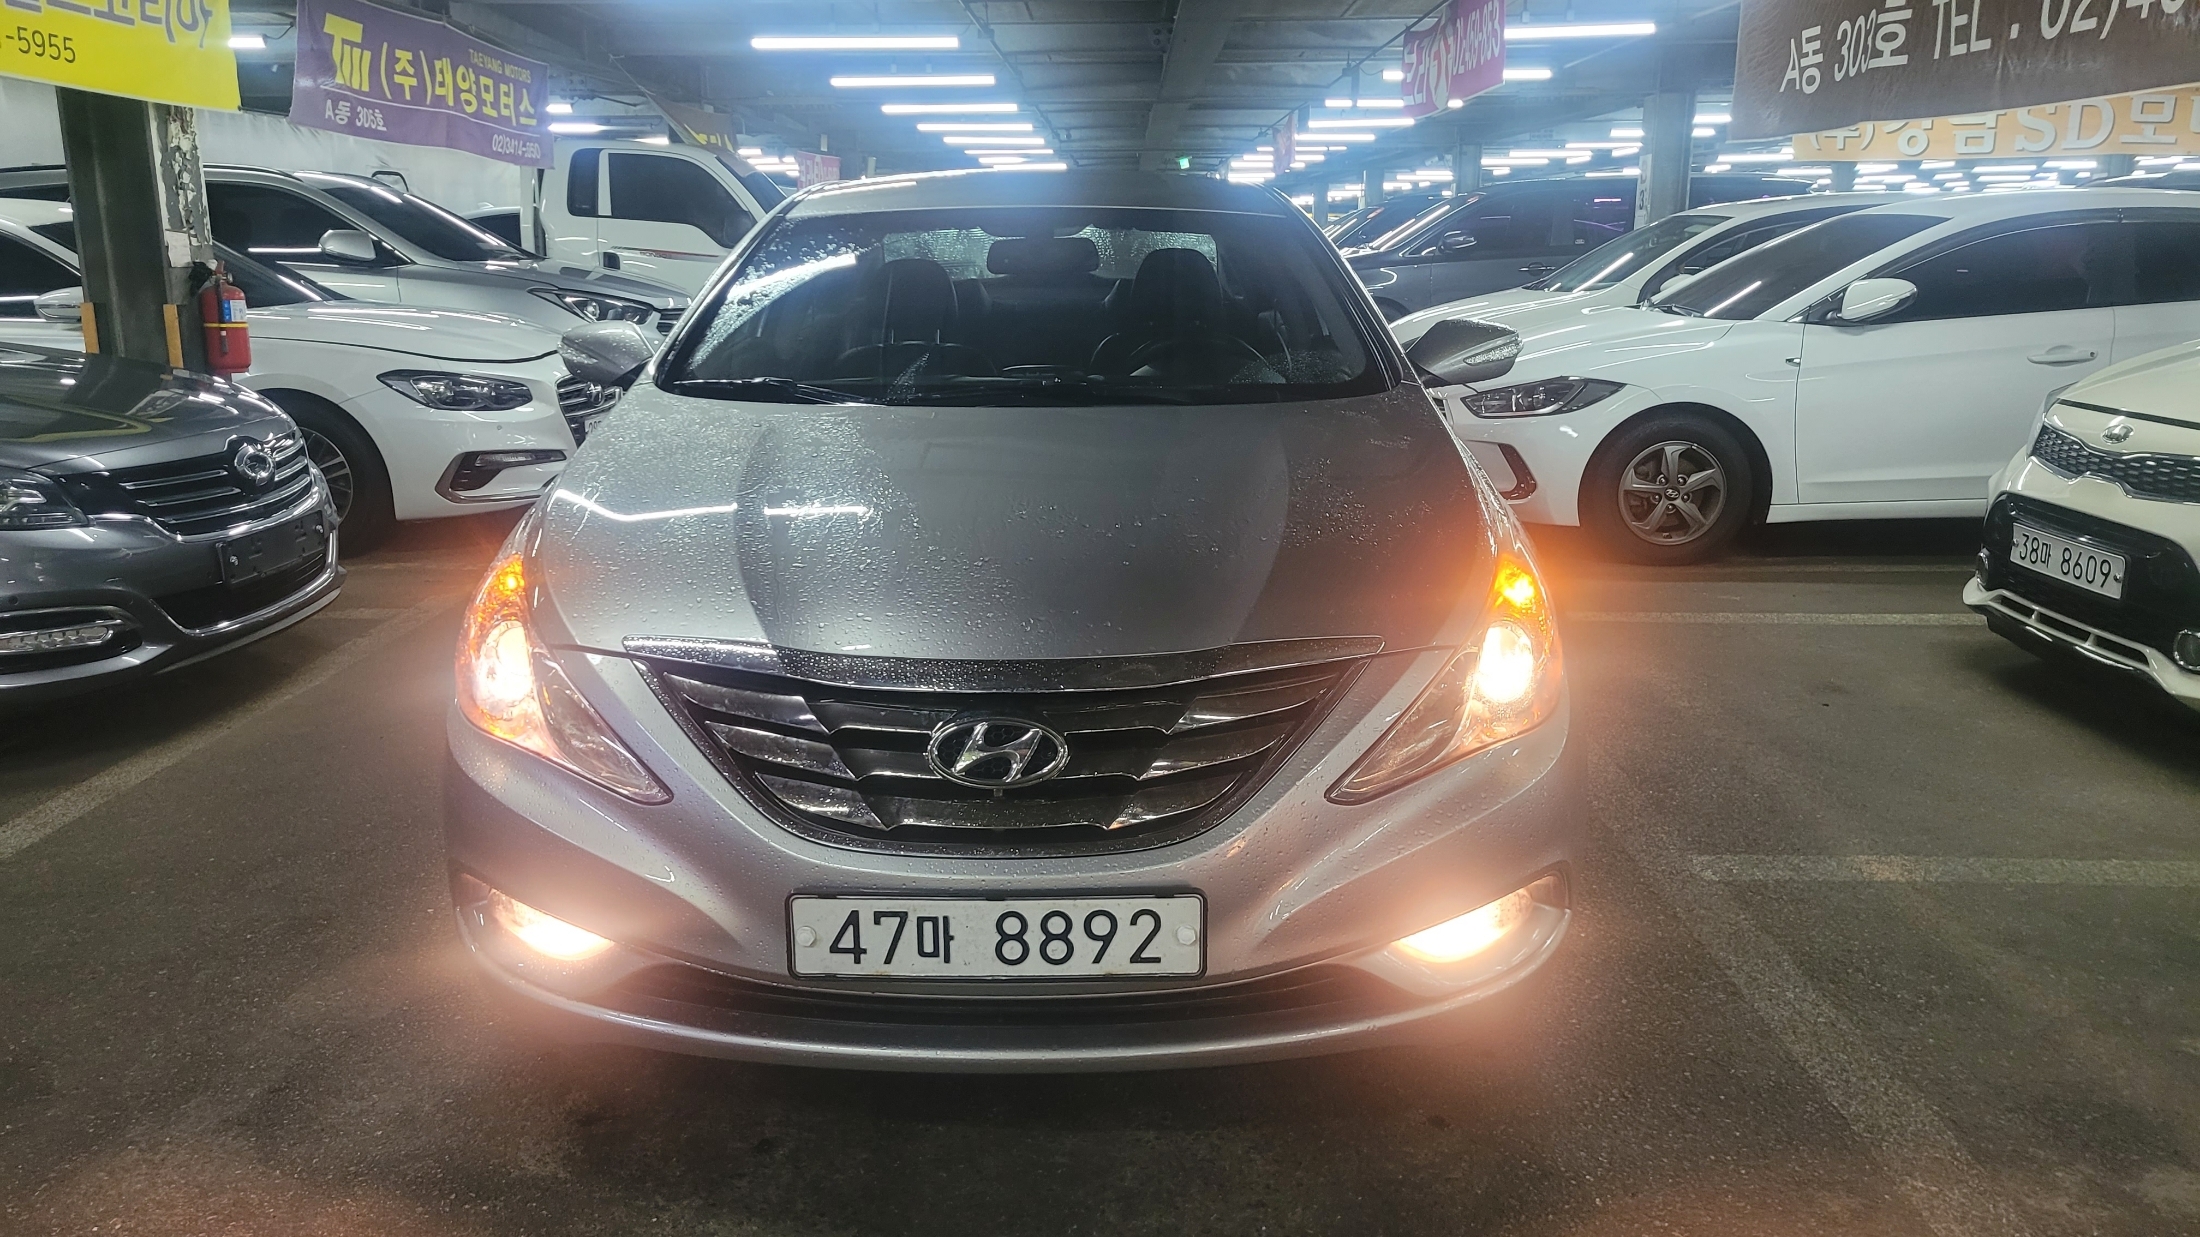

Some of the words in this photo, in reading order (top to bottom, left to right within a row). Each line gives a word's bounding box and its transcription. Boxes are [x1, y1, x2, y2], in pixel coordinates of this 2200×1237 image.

[0, 26, 76, 63] -5955
[468, 48, 503, 74] TAEYANG
[504, 62, 531, 84] MOTORS
[1779, 25, 1823, 94] A동
[1834, 0, 1913, 81] 303호
[325, 98, 351, 125] A동
[2019, 533, 2052, 569] 38마
[2060, 547, 2112, 588] 8609
[829, 910, 955, 965] 47마
[994, 909, 1162, 966] 8892
